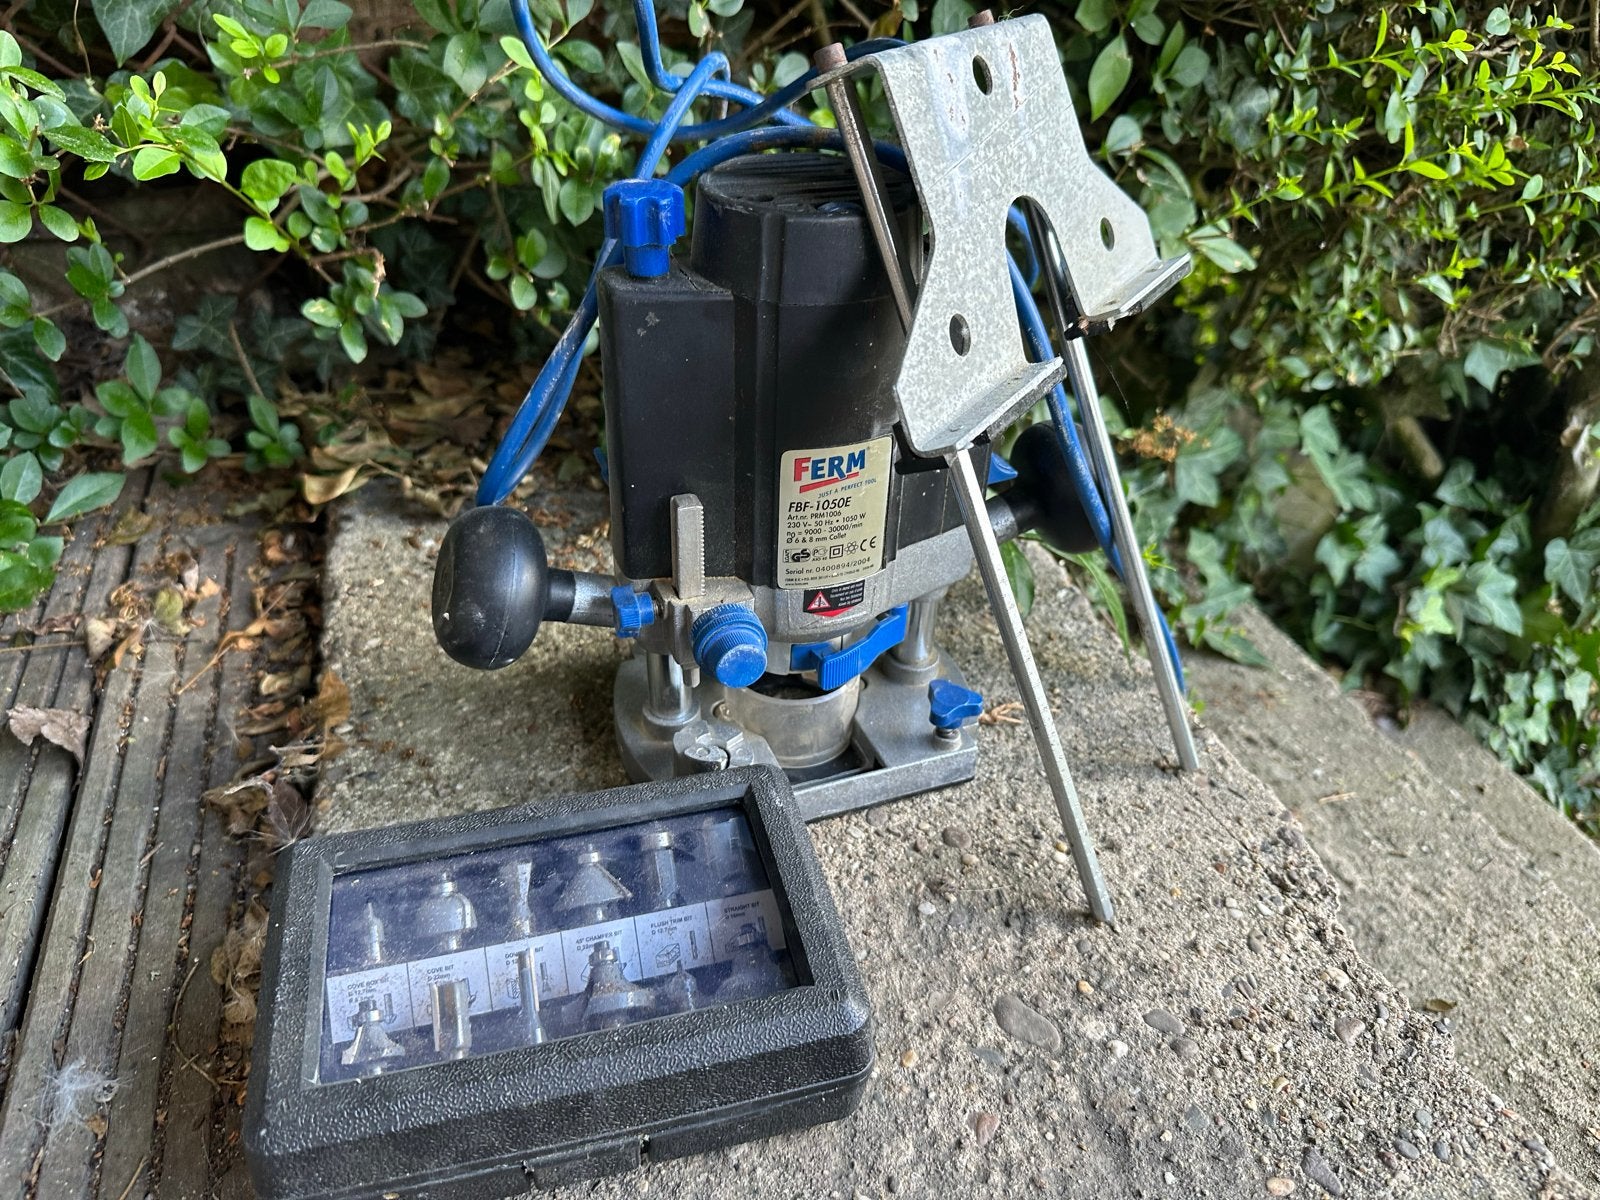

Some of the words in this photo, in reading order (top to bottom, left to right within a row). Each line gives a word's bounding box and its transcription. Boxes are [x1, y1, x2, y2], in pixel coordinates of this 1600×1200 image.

[794, 449, 866, 482] FERM
[818, 491, 833, 499] JUST
[840, 481, 863, 491] PERFECT
[788, 496, 852, 513] FBF-1050E
[810, 510, 842, 519] PRM1006
[787, 521, 801, 529] 230
[842, 515, 858, 523] 1050
[804, 528, 822, 536] 9000
[828, 522, 864, 534] 30000/min
[808, 535, 814, 543] 8
[829, 533, 847, 541] Collet
[785, 567, 804, 575] Serial
[650, 920, 669, 929] FLUSH
[670, 917, 683, 925] TRIM
[426, 966, 444, 975] COVE
[347, 981, 366, 991] COVE
